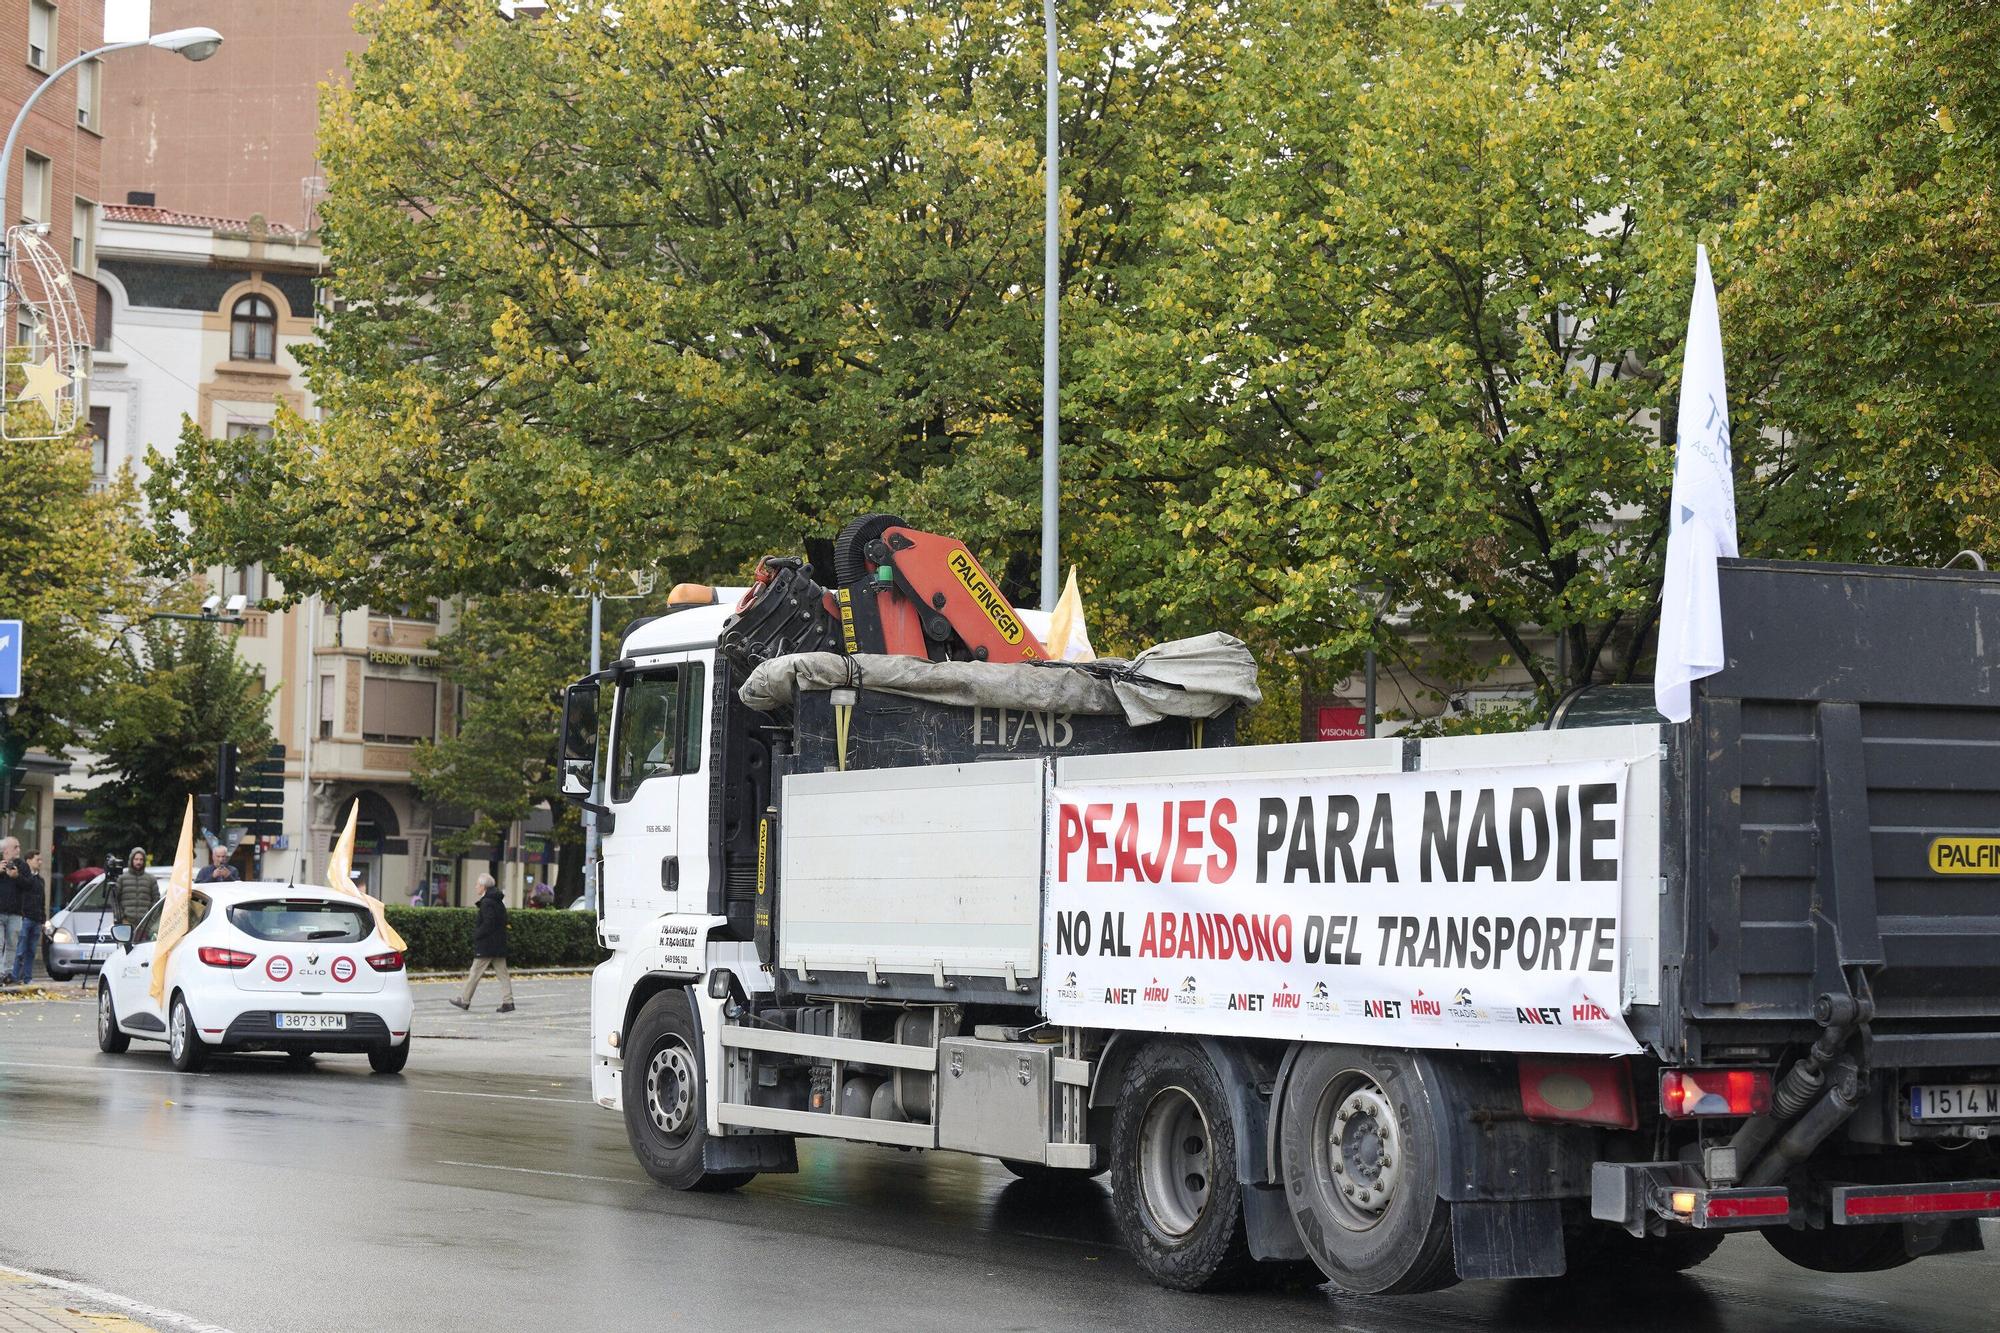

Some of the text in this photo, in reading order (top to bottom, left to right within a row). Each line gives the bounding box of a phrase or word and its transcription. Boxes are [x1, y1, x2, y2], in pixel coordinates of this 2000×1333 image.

[951, 554, 1019, 640] PALFINGER
[369, 650, 411, 665] PENSION
[1320, 728, 1366, 737] VISIONLAB
[1059, 783, 1618, 884] PEAJES PARA NADIE
[758, 823, 766, 890] PALFINGER
[1057, 911, 1618, 972] NO AL ABANDONO DEL TRANSPORTE
[1104, 987, 1137, 1005] ANET
[1143, 987, 1170, 1003] HIRU
[1227, 993, 1265, 1012] ANET
[1272, 993, 1301, 1009] HIRU
[1364, 999, 1401, 1019] ANET
[1411, 999, 1441, 1016] HIRU
[1516, 1007, 1563, 1025] ANET
[1572, 1004, 1611, 1021] HIRU
[285, 1015, 317, 1026] 3873
[1929, 1089, 1979, 1114] 1514
[1986, 1089, 1998, 1113] M
